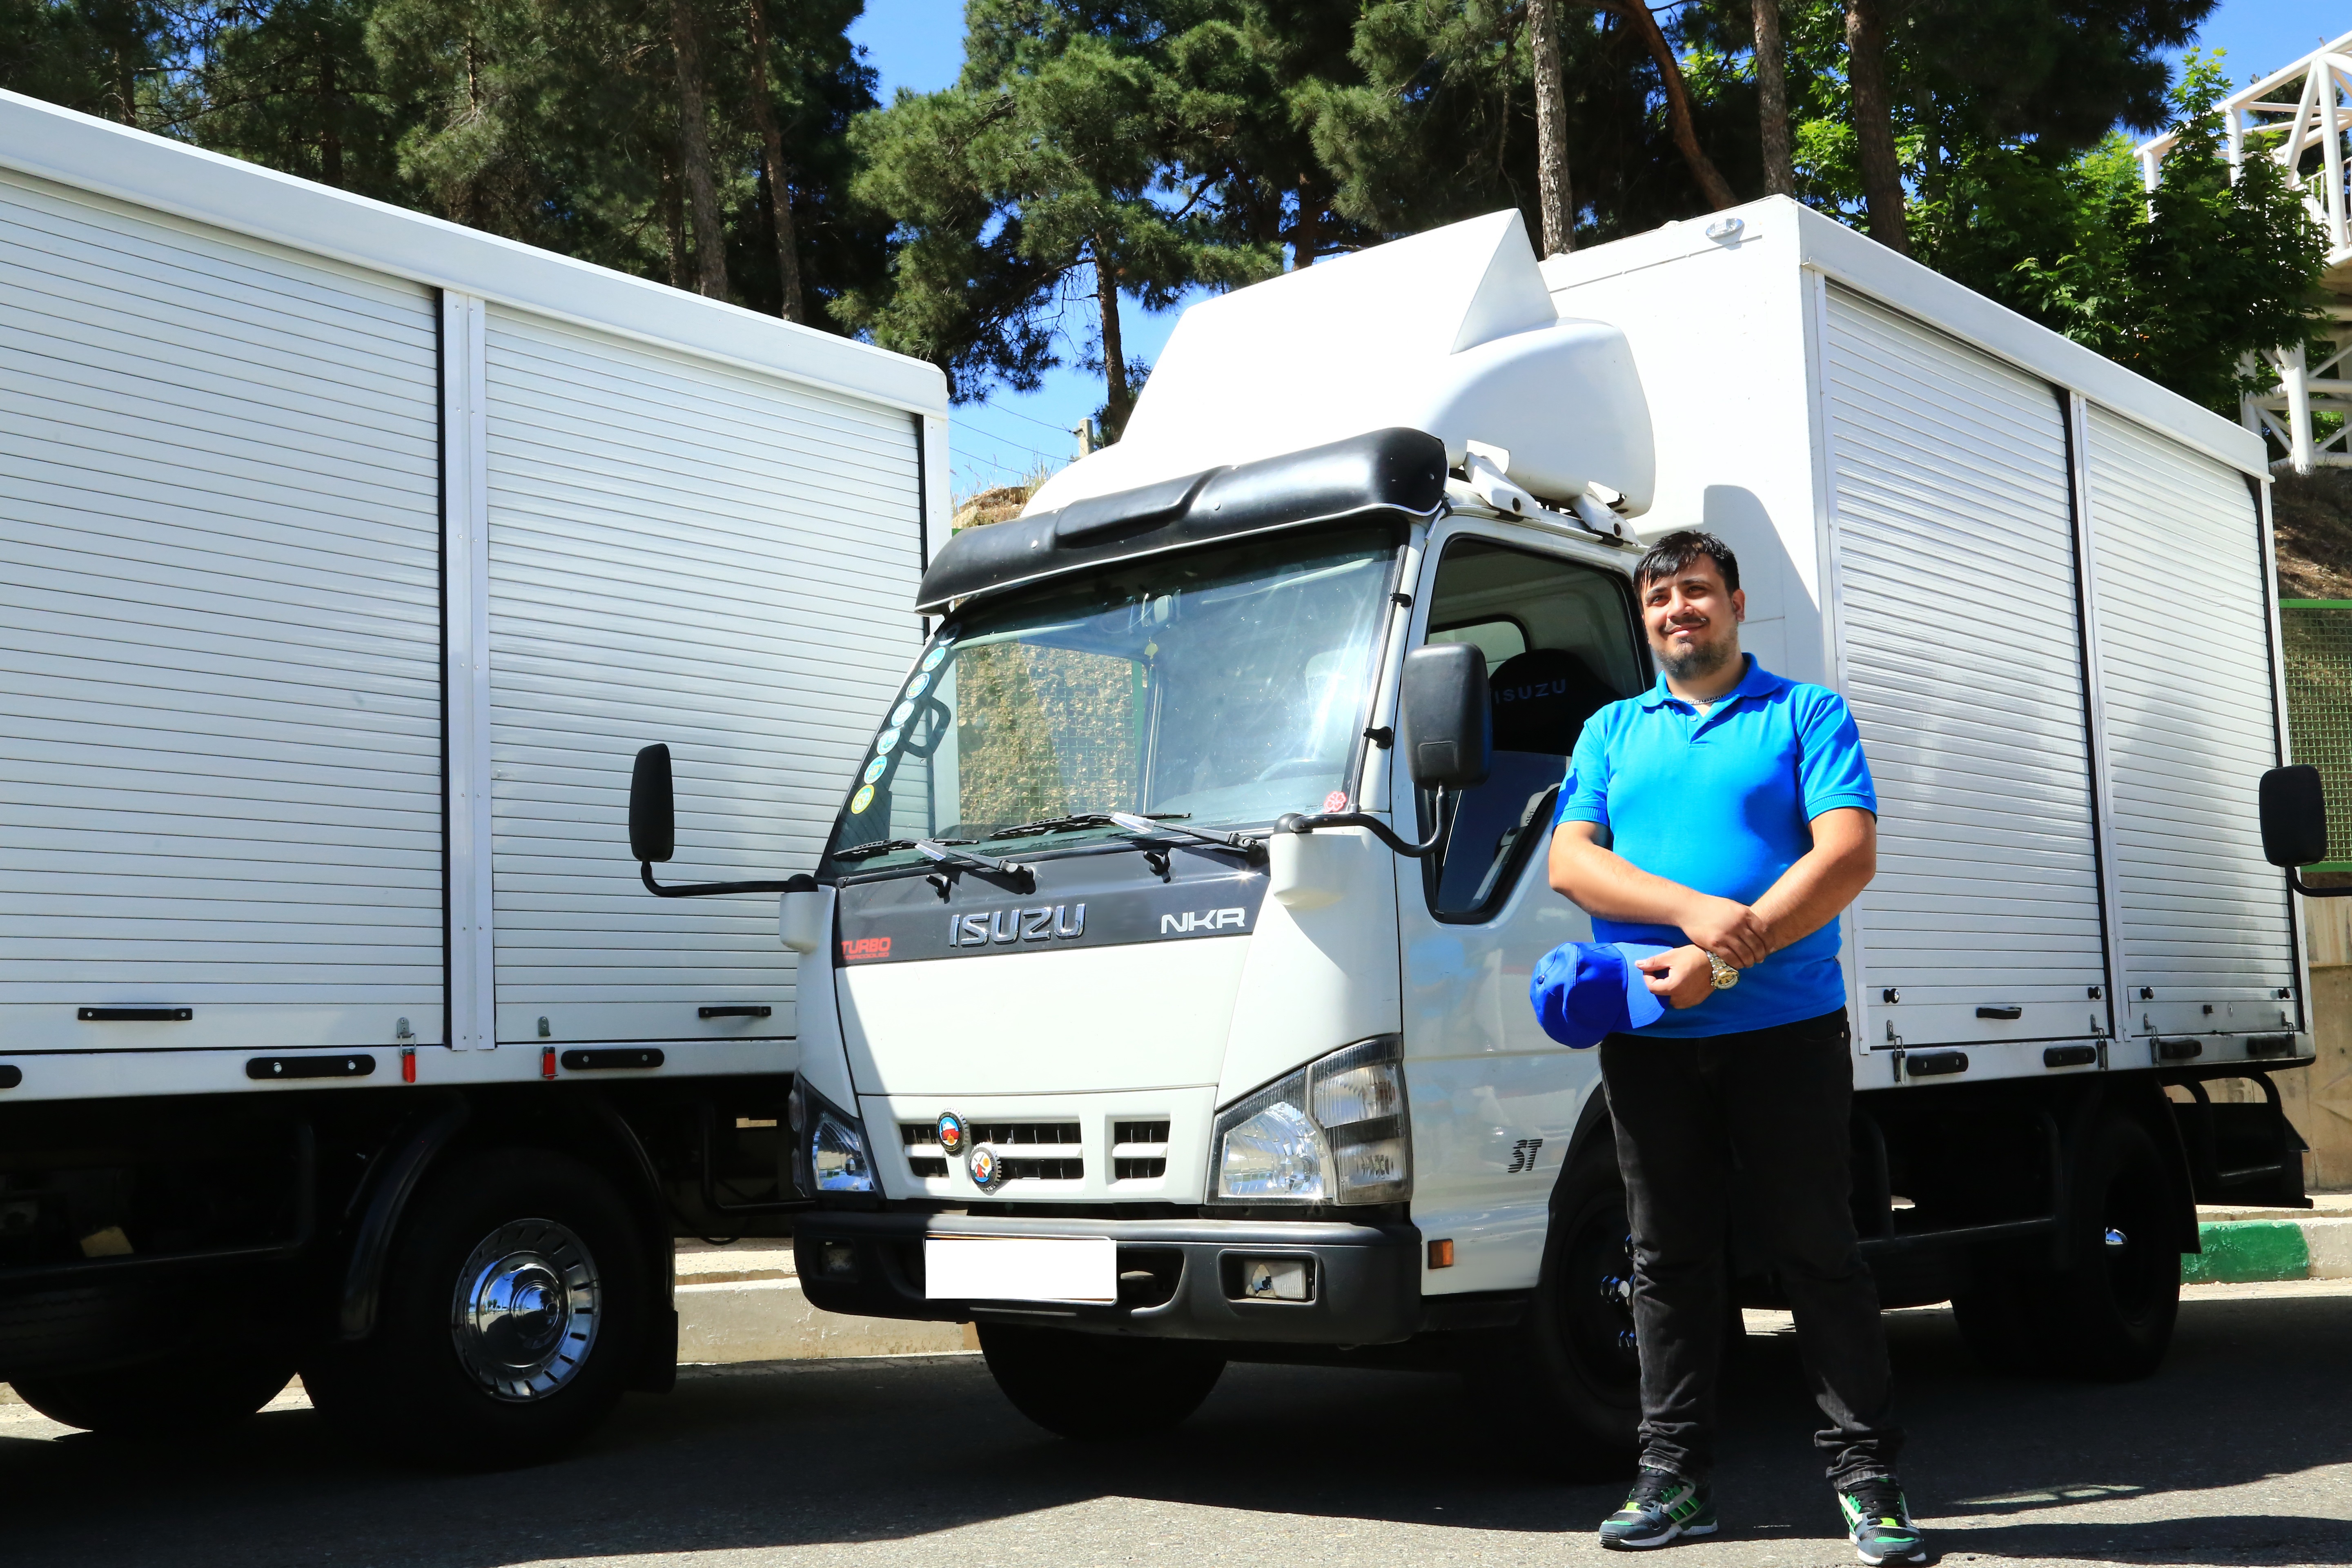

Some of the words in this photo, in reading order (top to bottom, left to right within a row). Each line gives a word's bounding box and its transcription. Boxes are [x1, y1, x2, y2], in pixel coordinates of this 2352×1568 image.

[1494, 679, 1566, 704] ISUZU
[949, 903, 1086, 948] ISUZU
[1160, 907, 1245, 934] NKR
[841, 937, 891, 955] TURBO
[1507, 1138, 1544, 1173] ST
